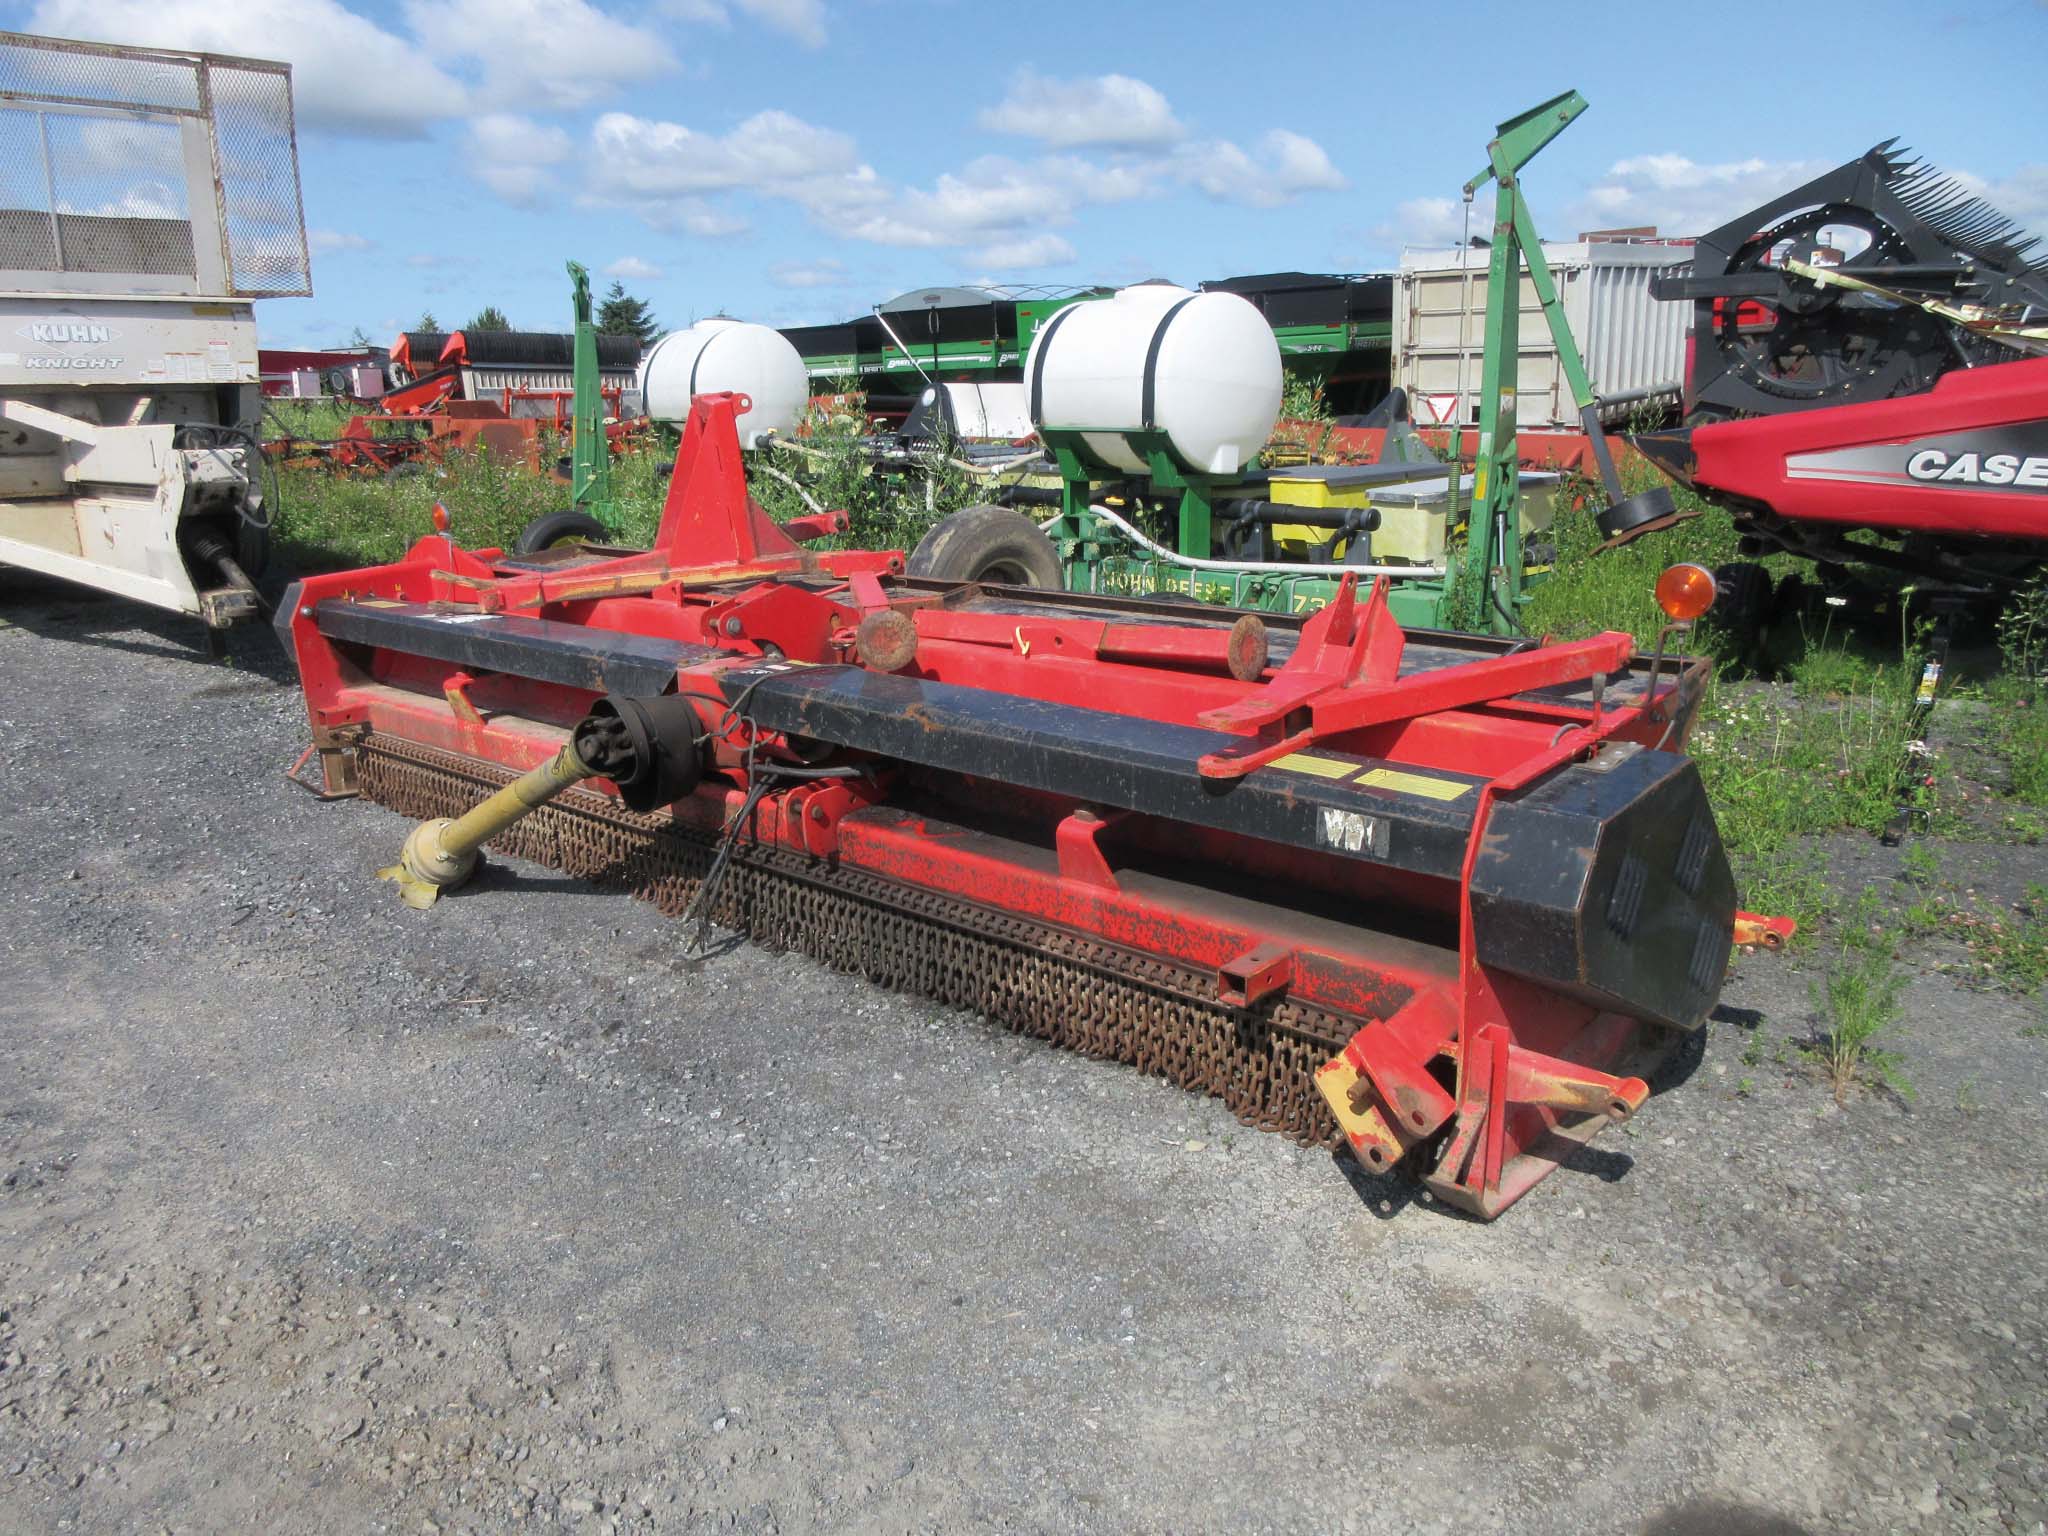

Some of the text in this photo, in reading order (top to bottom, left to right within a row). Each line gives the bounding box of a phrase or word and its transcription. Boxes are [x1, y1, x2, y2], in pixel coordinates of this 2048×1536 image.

[32, 323, 111, 343] KUHN
[25, 357, 124, 369] KNIGHT
[1909, 450, 2048, 487] CASE
[1107, 571, 1232, 604] JOHN DEERE
[1293, 594, 1335, 613] 73
